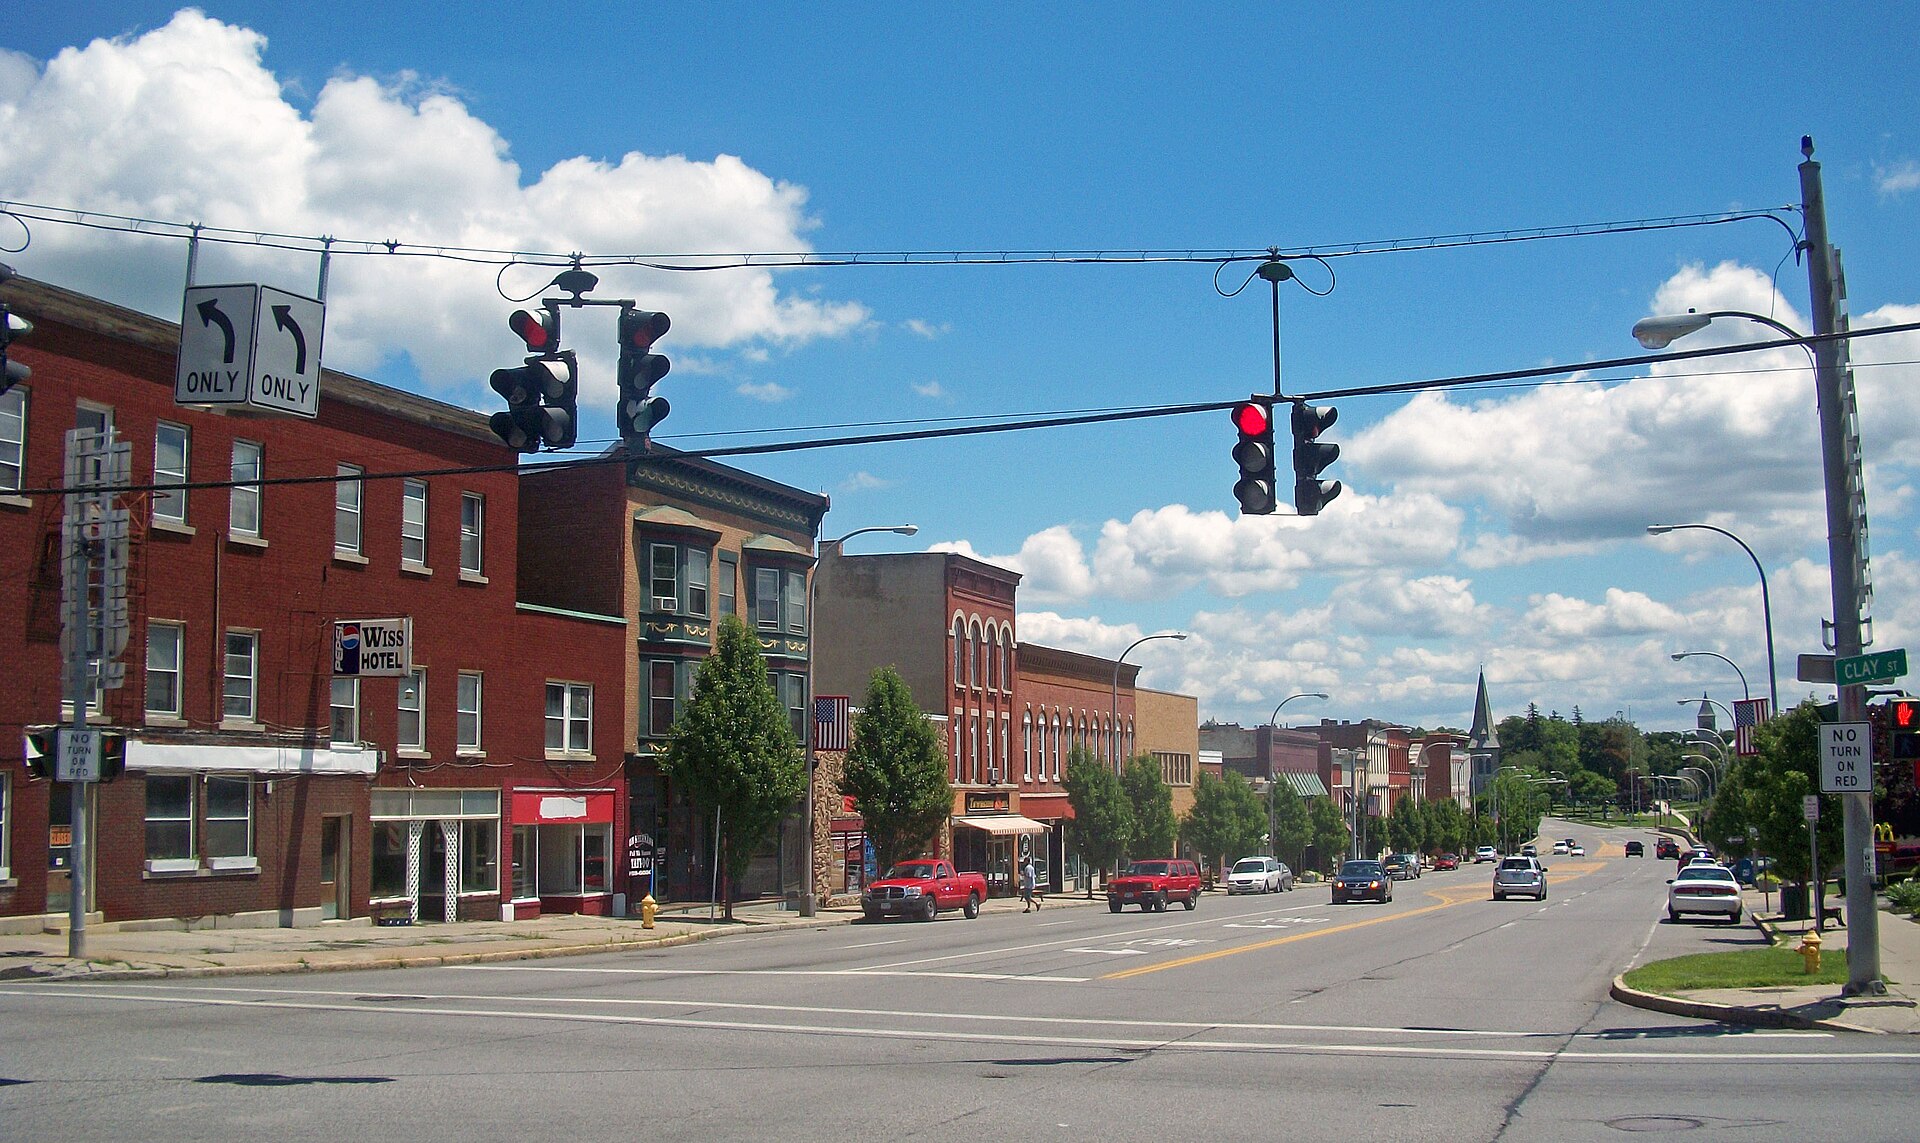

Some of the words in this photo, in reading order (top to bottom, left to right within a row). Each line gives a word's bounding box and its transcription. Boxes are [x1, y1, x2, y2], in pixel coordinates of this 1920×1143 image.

[187, 370, 239, 393] ONLY
[261, 374, 310, 403] ONLY
[335, 624, 344, 672] PEPSI
[361, 652, 403, 669] HOTEL
[1844, 659, 1878, 679] CLAY
[1887, 660, 1897, 672] ST
[70, 734, 89, 744] NO
[1833, 729, 1856, 742] NO
[67, 746, 91, 755] TURN
[1830, 746, 1861, 757] TURN
[72, 758, 86, 766] ON
[1837, 761, 1855, 772] ON
[69, 768, 88, 777] RED
[1835, 776, 1858, 787] RED
[50, 832, 71, 845] CLOSED
